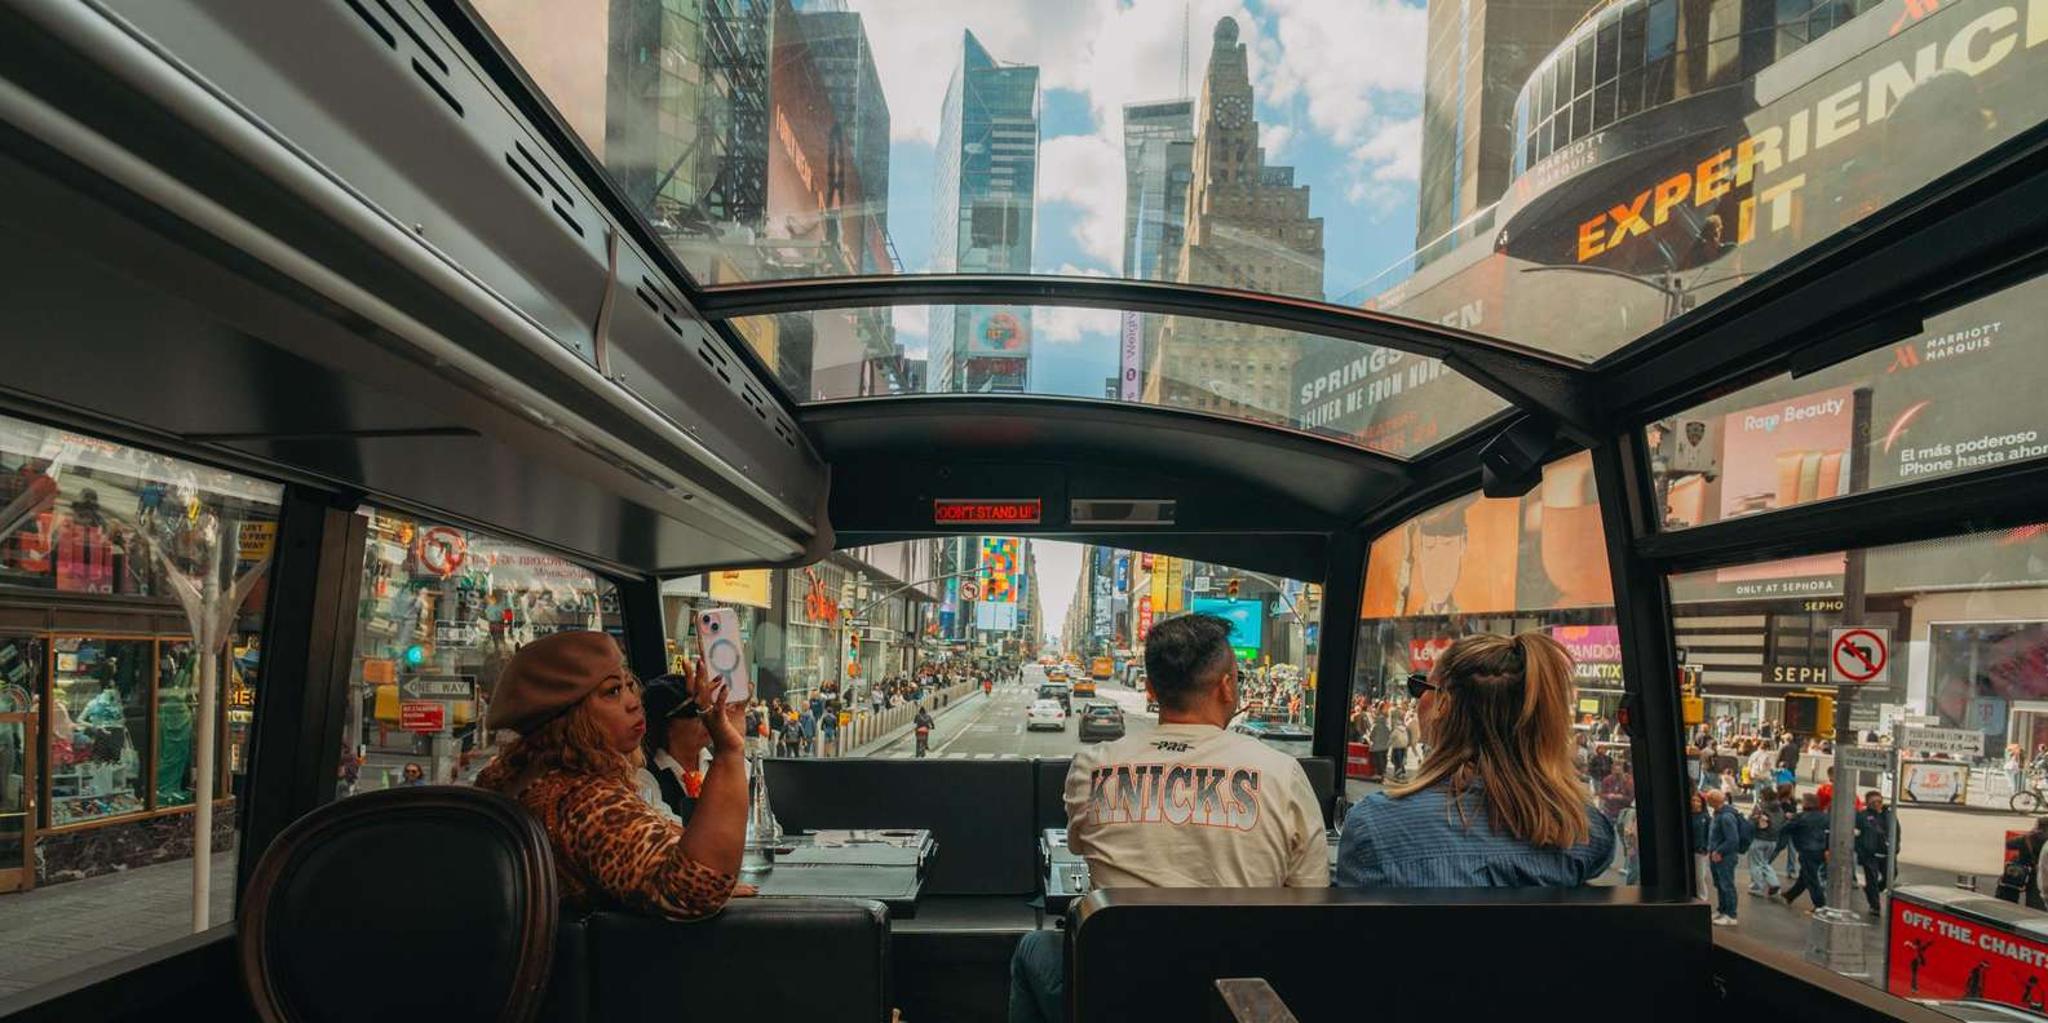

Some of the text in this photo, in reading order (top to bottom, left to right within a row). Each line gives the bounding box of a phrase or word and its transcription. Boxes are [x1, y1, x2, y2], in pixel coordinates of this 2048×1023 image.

[1738, 173, 1806, 246] IT
[1926, 321, 2002, 348] MARRIOTT
[1926, 337, 1991, 361] MARQUIS
[1346, 387, 1363, 414] ME
[1368, 373, 1403, 405] FROM
[1784, 399, 1844, 422] Beauty
[1901, 430, 2037, 462] El más poderoso
[1900, 459, 1953, 477] iPhone
[1957, 451, 2004, 468] hasta
[977, 505, 1017, 519] STAND
[1736, 580, 1834, 595] ONLY AT SEPHORA
[1774, 666, 1827, 683] SEPH
[409, 681, 466, 695] ONE WAY
[1089, 763, 1261, 832] KNICKS
[1902, 910, 1934, 932] OFF.
[1937, 920, 1975, 946] THE.
